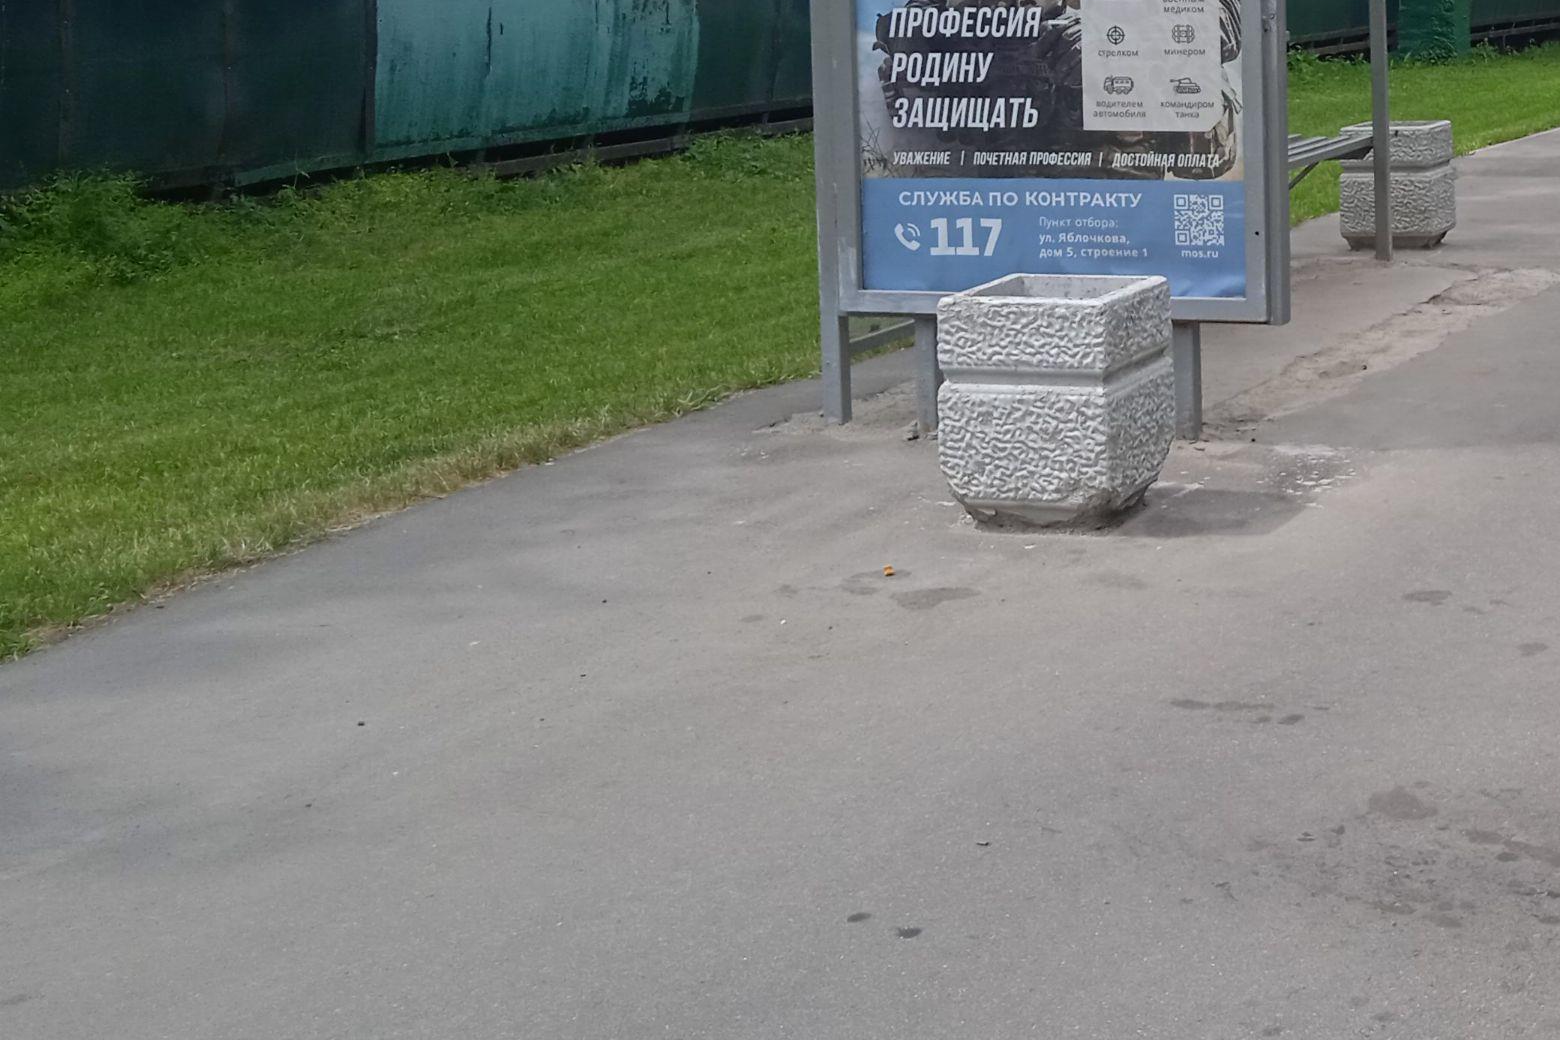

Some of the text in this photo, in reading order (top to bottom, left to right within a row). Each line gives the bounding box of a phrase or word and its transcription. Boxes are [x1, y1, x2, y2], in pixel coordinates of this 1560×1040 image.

[1163, 7, 1205, 15] медиком
[889, 7, 1042, 39] ПРОФЕССИЯ
[1098, 50, 1139, 58] стрелком
[1164, 49, 1206, 57] минером
[890, 52, 994, 87] РОДИНУ
[1096, 101, 1143, 109] водителем
[1160, 101, 1215, 110] командиром
[892, 97, 1039, 132] ЗАЩИЩАТЬ
[1093, 109, 1146, 118] автомобиля
[893, 151, 1220, 168] УВАЖЕНИЕ ПОЧЕТНАЯ ПРОФЕССИЯ ДОСТОЙНАЯ ОПЛАТА
[899, 191, 1143, 208] СЛУЖБА ПО КОНТРАКТУ
[1039, 216, 1119, 229] Пункт отбора:
[930, 217, 1003, 257] 117
[1039, 232, 1130, 245] ул. Яблочкова,
[1039, 247, 1148, 259] дом 5, строение 1
[1181, 249, 1219, 258] mos.ru
